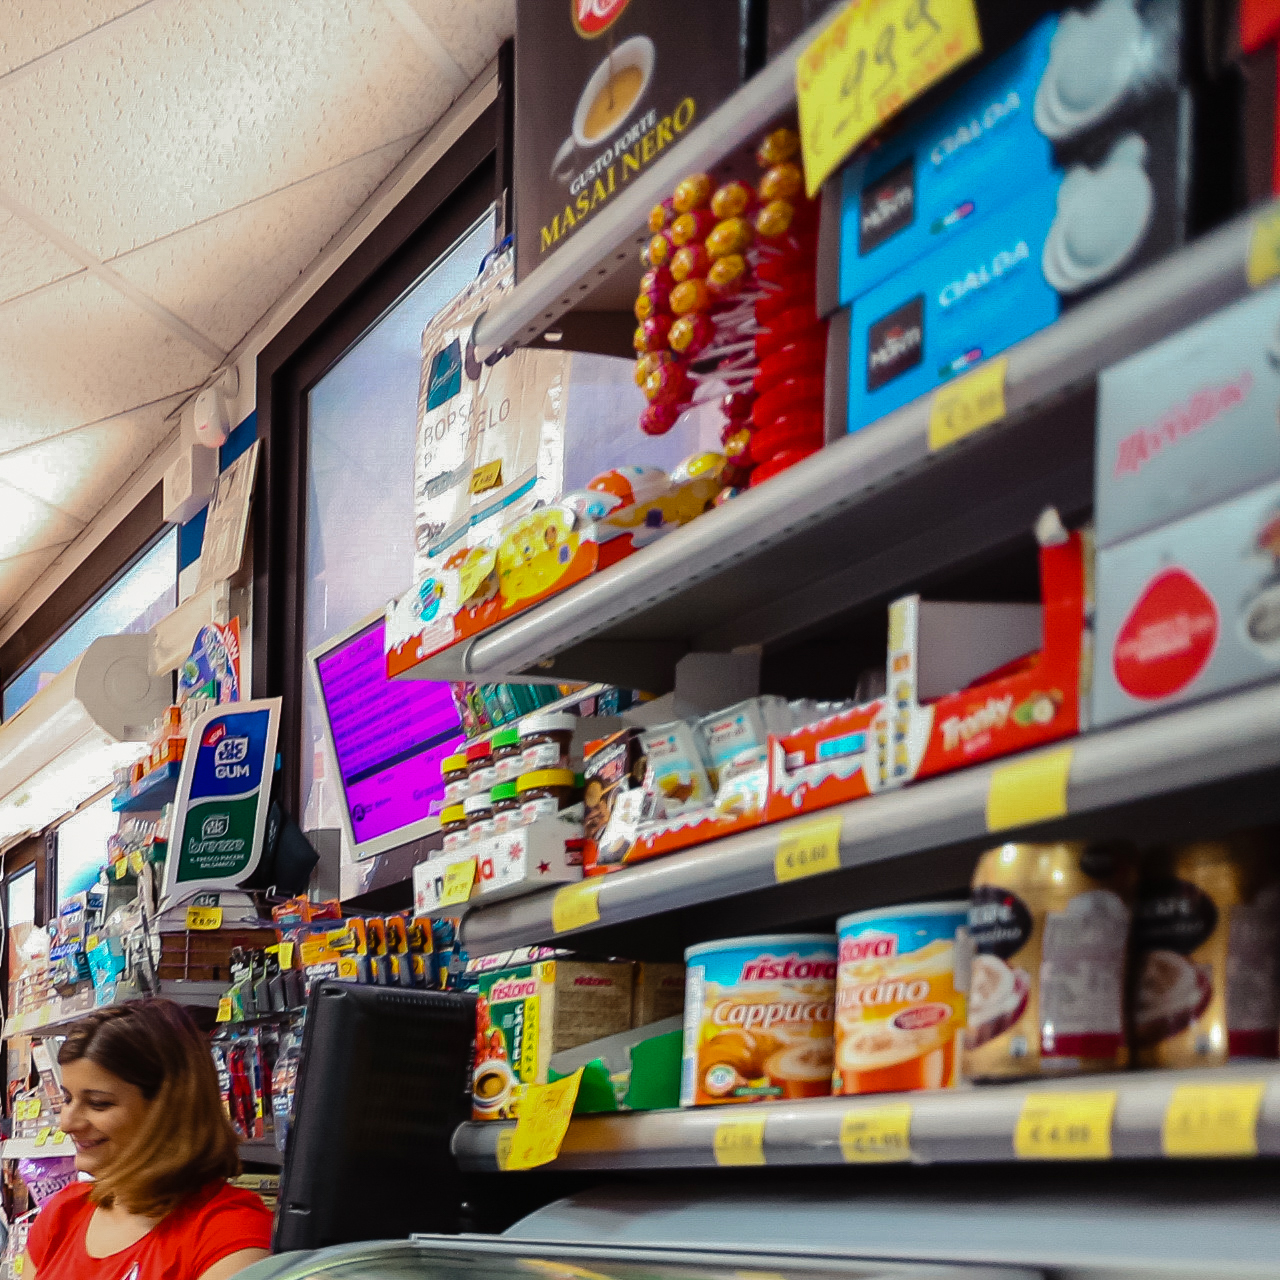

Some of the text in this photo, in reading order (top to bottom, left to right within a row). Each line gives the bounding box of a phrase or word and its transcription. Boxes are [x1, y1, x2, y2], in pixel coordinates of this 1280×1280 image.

[570, 108, 657, 195] GUSTO FORTE
[541, 97, 696, 252] MASAI NERO
[224, 740, 243, 751] tic
[215, 764, 250, 779] GUM
[840, 935, 894, 963] tora
[492, 979, 537, 1001] ristora
